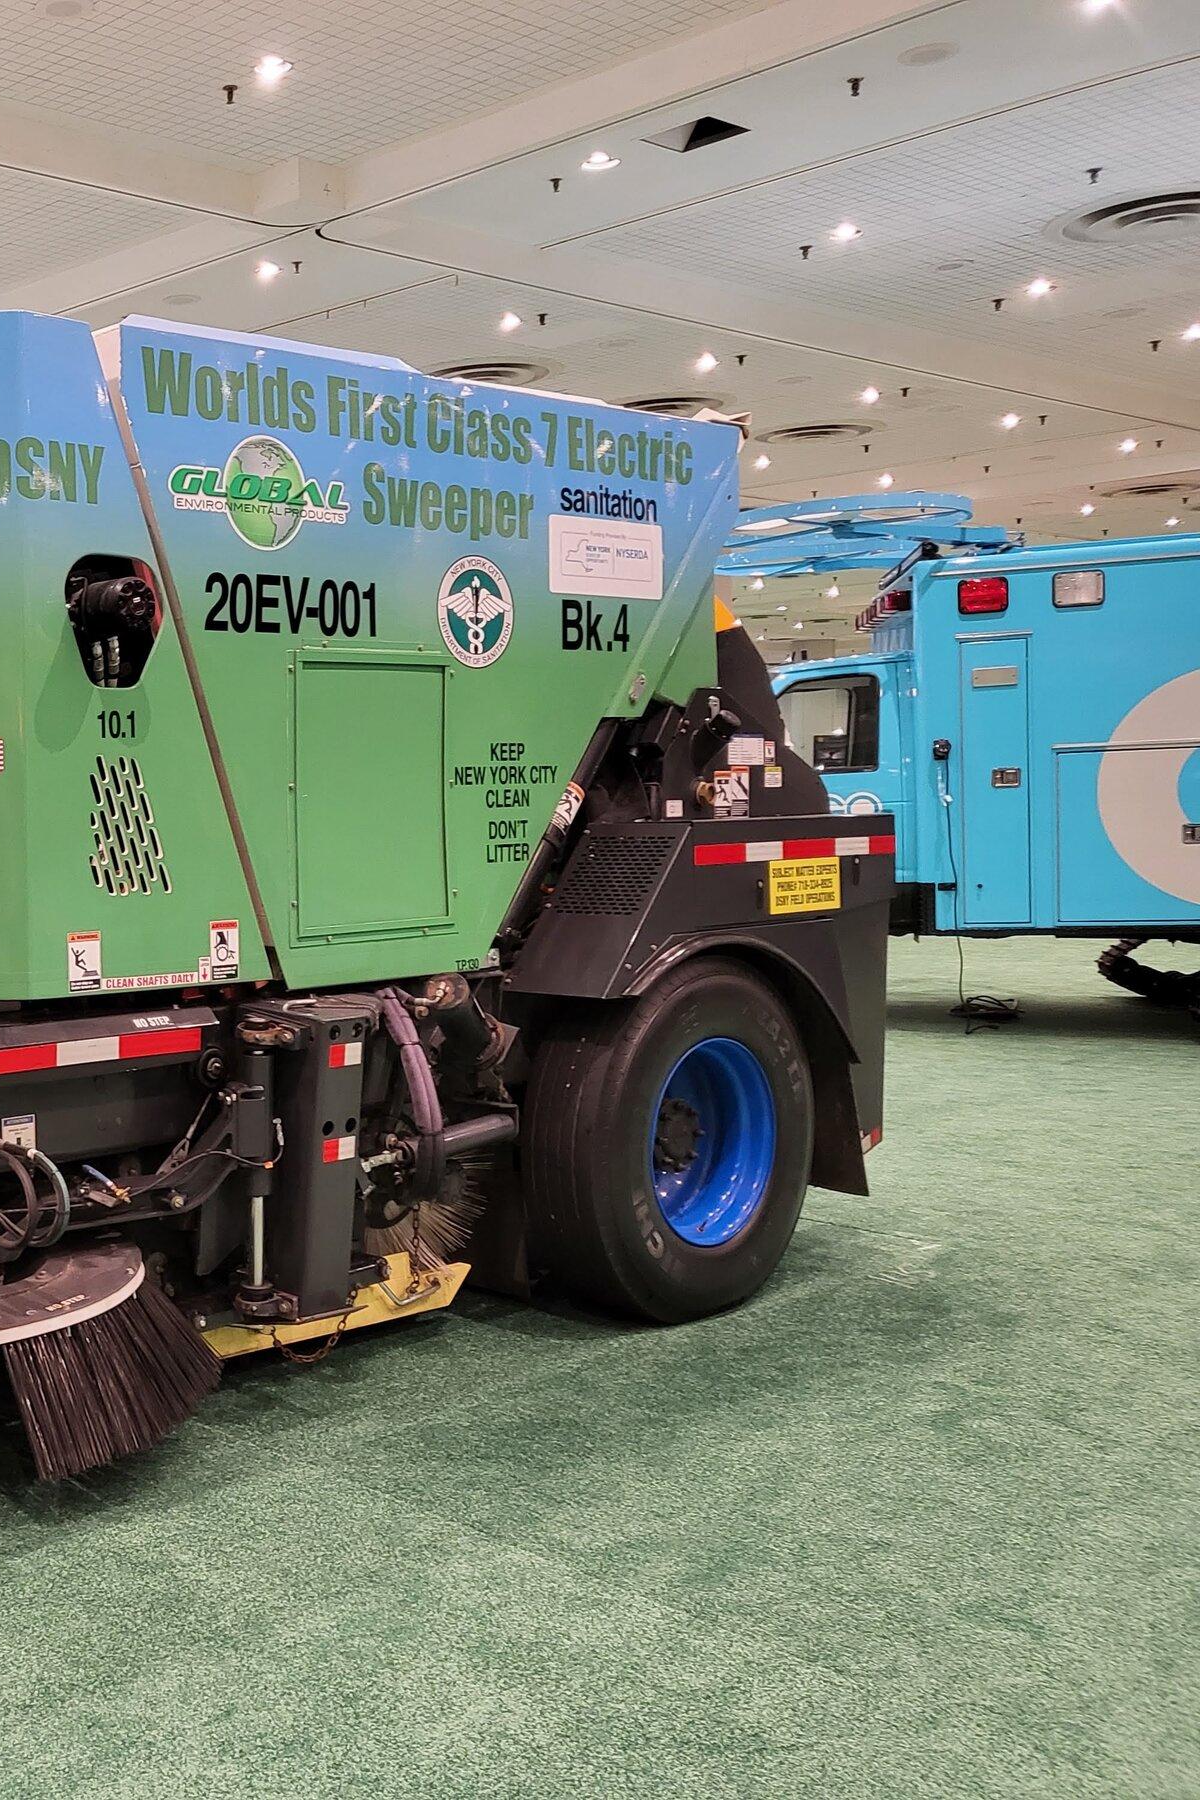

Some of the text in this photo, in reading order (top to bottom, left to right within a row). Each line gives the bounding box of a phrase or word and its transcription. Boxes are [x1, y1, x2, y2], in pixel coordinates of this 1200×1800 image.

[141, 346, 693, 485] Worlds First Class 7 Electric
[171, 468, 348, 510] GLOBAL
[176, 498, 345, 521] ENVIRONMENTAL PRODUCTS
[362, 462, 534, 541] Sweeper
[560, 484, 657, 522] sanitation
[616, 548, 648, 559] NYSERDA
[450, 559, 503, 582] NEW YORK CITY
[204, 572, 377, 637] 20EV-001
[562, 599, 630, 652] Bk.4
[440, 617, 511, 664] DEPARTMENT OF SANITATION
[97, 710, 136, 739] 10.1
[490, 743, 525, 761] KEEP
[454, 765, 558, 785] NEW YORK CITY
[485, 789, 530, 808] CLEAN
[488, 820, 528, 839] DON'T
[486, 843, 529, 863] LITTER
[106, 976, 134, 989] CLEAN
[136, 974, 169, 987] SHAFTS
[171, 973, 195, 984] DAILY
[133, 1016, 170, 1028] NO STEP
